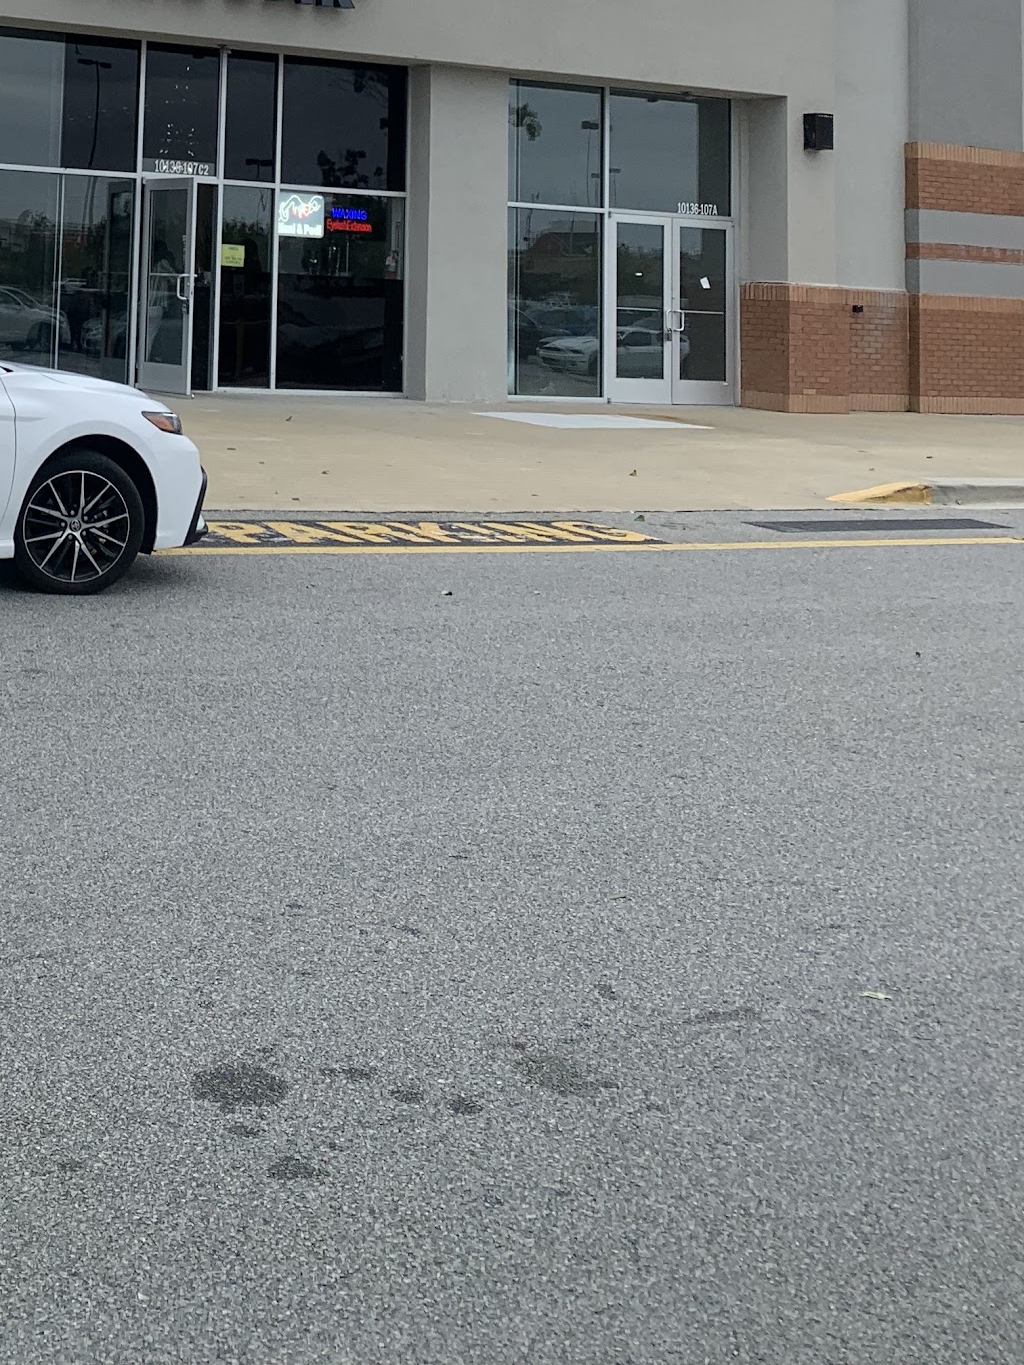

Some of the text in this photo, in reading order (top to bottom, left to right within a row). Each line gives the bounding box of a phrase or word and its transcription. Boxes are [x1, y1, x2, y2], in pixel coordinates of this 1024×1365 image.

[154, 159, 210, 176] 10136-107C2
[331, 207, 368, 221] WAXING
[677, 201, 719, 216] 10136-107A
[207, 521, 660, 544] PARKING
